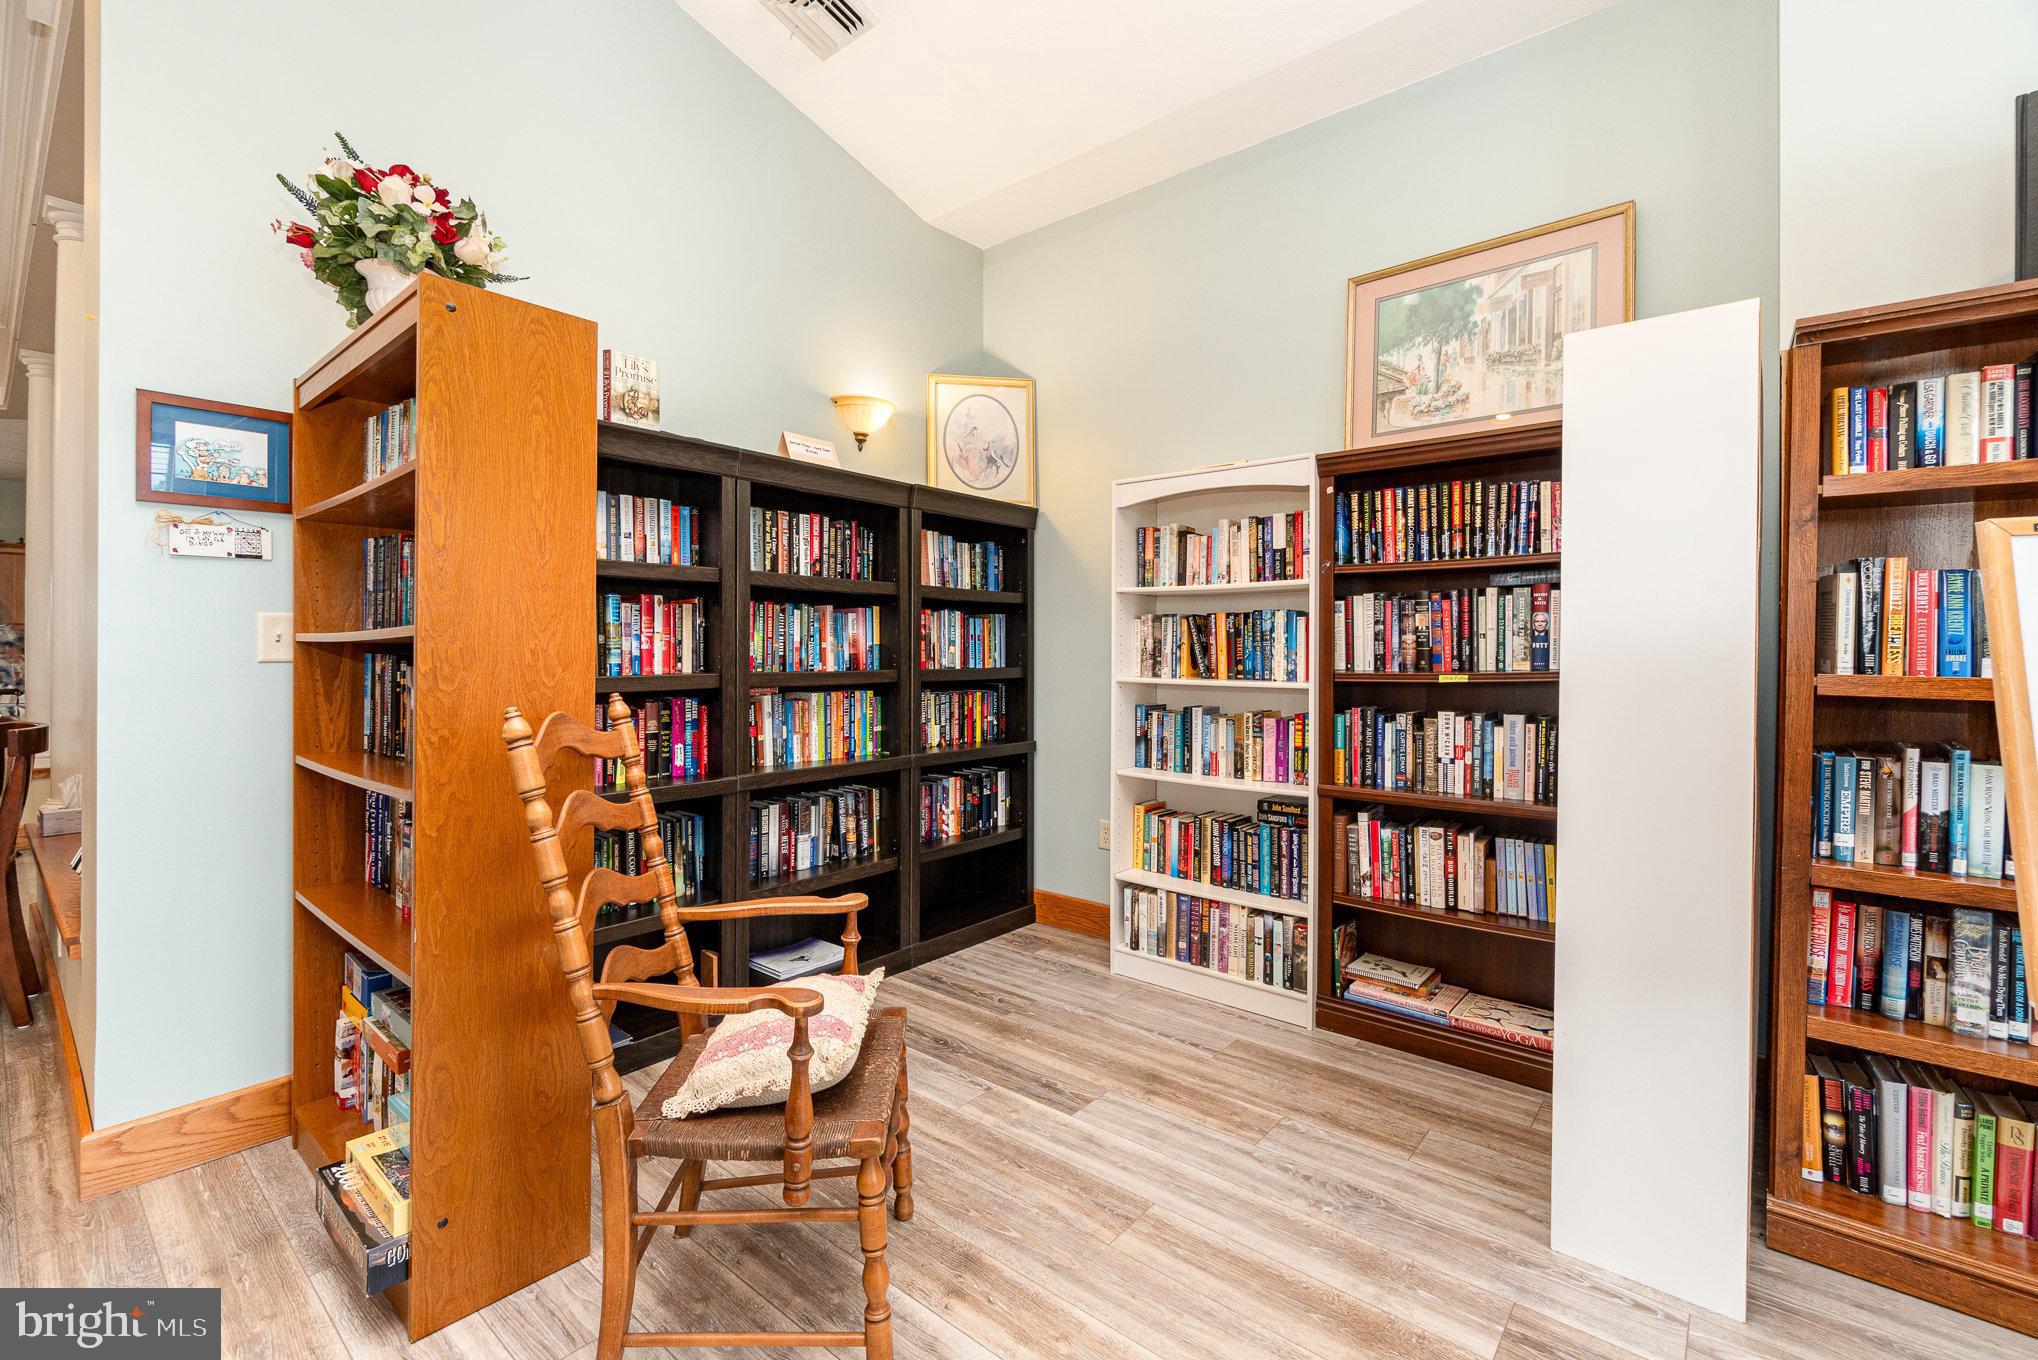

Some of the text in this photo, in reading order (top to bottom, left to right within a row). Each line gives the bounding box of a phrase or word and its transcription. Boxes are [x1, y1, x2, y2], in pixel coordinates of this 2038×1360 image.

[615, 366, 657, 385] Promise
[624, 356, 649, 373] Lily's
[1898, 402, 1908, 417] Snow
[1924, 381, 1935, 419] LISA GARDNER
[1898, 418, 1908, 434] Falling
[2019, 420, 2030, 428] IVY
[1898, 441, 1908, 458] Cedars
[1925, 428, 1936, 449] TOUCH
[1925, 454, 1936, 465] GO
[650, 500, 658, 540] DAVID BALDACCI
[1864, 560, 1872, 598] KOONTZ
[1892, 578, 1903, 610] KOONTZ
[1948, 573, 1964, 636] JAYNE ANN KRENTZ
[1918, 572, 1928, 660] DEAN KOONTZ RELENTLESS
[1888, 614, 1904, 664] BREATHLESS
[1824, 767, 1832, 778] THE
[1932, 772, 1940, 788] BRAD
[1824, 780, 1832, 800] WRONG
[1859, 771, 1872, 815] STEVE MARTINI
[1932, 788, 1940, 811] MELTZER
[1824, 802, 1832, 825] DOCTOR
[1840, 790, 1852, 833] EMPIRE
[1437, 862, 1442, 870] OF
[1810, 908, 1828, 958] LAKE HOUSE
[1836, 913, 1850, 951] JAMES PATTERSON
[1864, 908, 1876, 957] JAMES PATTERSON
[1910, 918, 1922, 962] JAMES PATTERSON
[1888, 920, 1903, 968] BEACH HOUSE
[1998, 930, 2007, 962] Ruth Rendell
[2015, 945, 2024, 964] PATRICK
[1952, 940, 1969, 980] Captivity
[1967, 947, 1990, 976] Bright
[1835, 969, 1847, 986] LONDON
[2015, 981, 2024, 996] DEATH
[1354, 989, 1378, 999] Container
[1405, 1002, 1429, 1012] FLORIDA
[1996, 964, 2006, 1016] No More Dying Then
[1858, 1115, 1866, 1123] The
[1858, 1123, 1866, 1133] Tides
[1828, 1144, 1837, 1167] SEWELL
[1858, 1138, 1866, 1154] Memory
[1916, 1130, 1928, 1194] Fred Mustard Stewar
